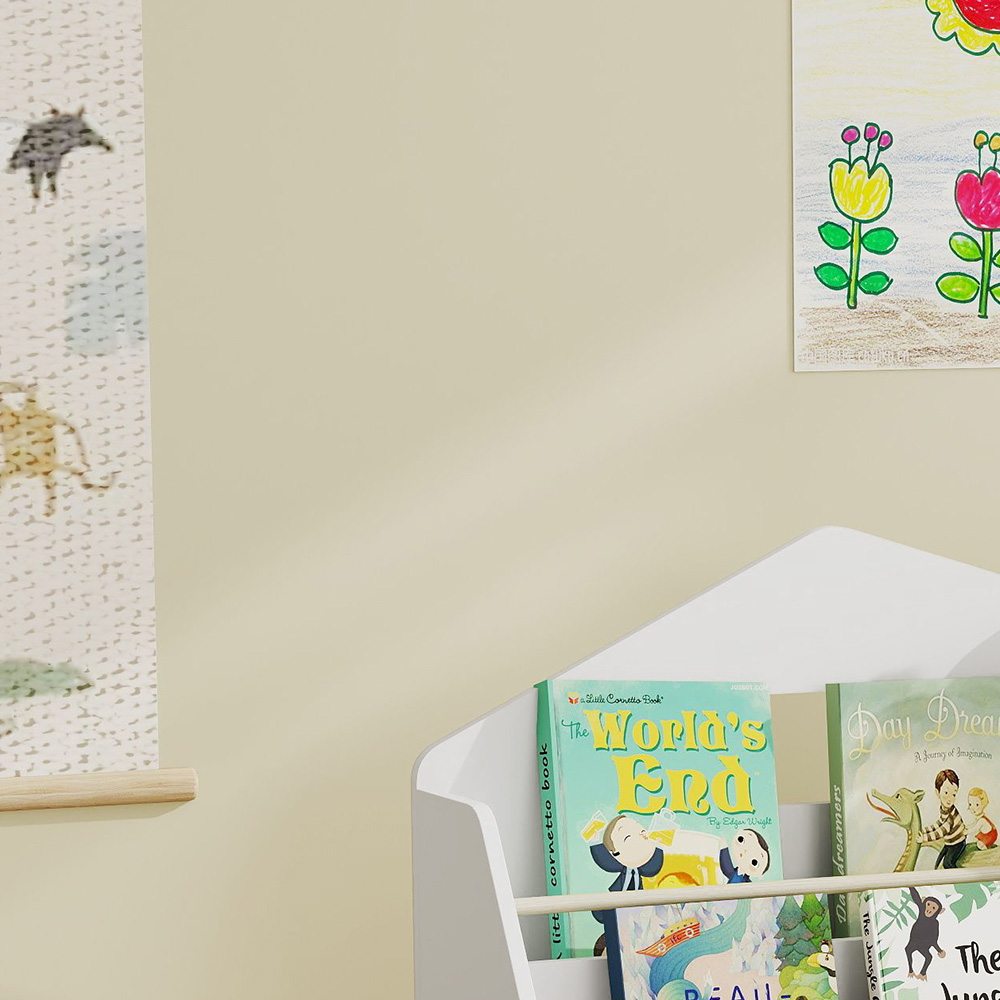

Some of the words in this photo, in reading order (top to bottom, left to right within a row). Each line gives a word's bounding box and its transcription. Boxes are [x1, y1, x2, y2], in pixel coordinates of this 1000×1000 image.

[586, 693, 606, 704] Little
[606, 693, 641, 704] Cornetto
[561, 719, 589, 739] The
[583, 710, 767, 752] World's
[848, 701, 911, 760] Day
[914, 751, 921, 763] A
[923, 749, 947, 763] Journey
[948, 747, 955, 757] of
[956, 746, 993, 760] Imagination
[539, 743, 550, 791] book
[611, 753, 756, 816] End
[544, 800, 558, 887] cornetto
[707, 816, 720, 829] By
[723, 816, 746, 829] Edgar
[747, 816, 772, 829] Wright
[833, 785, 845, 876] dreamers
[836, 893, 846, 924] Da
[866, 941, 877, 991] Jungle
